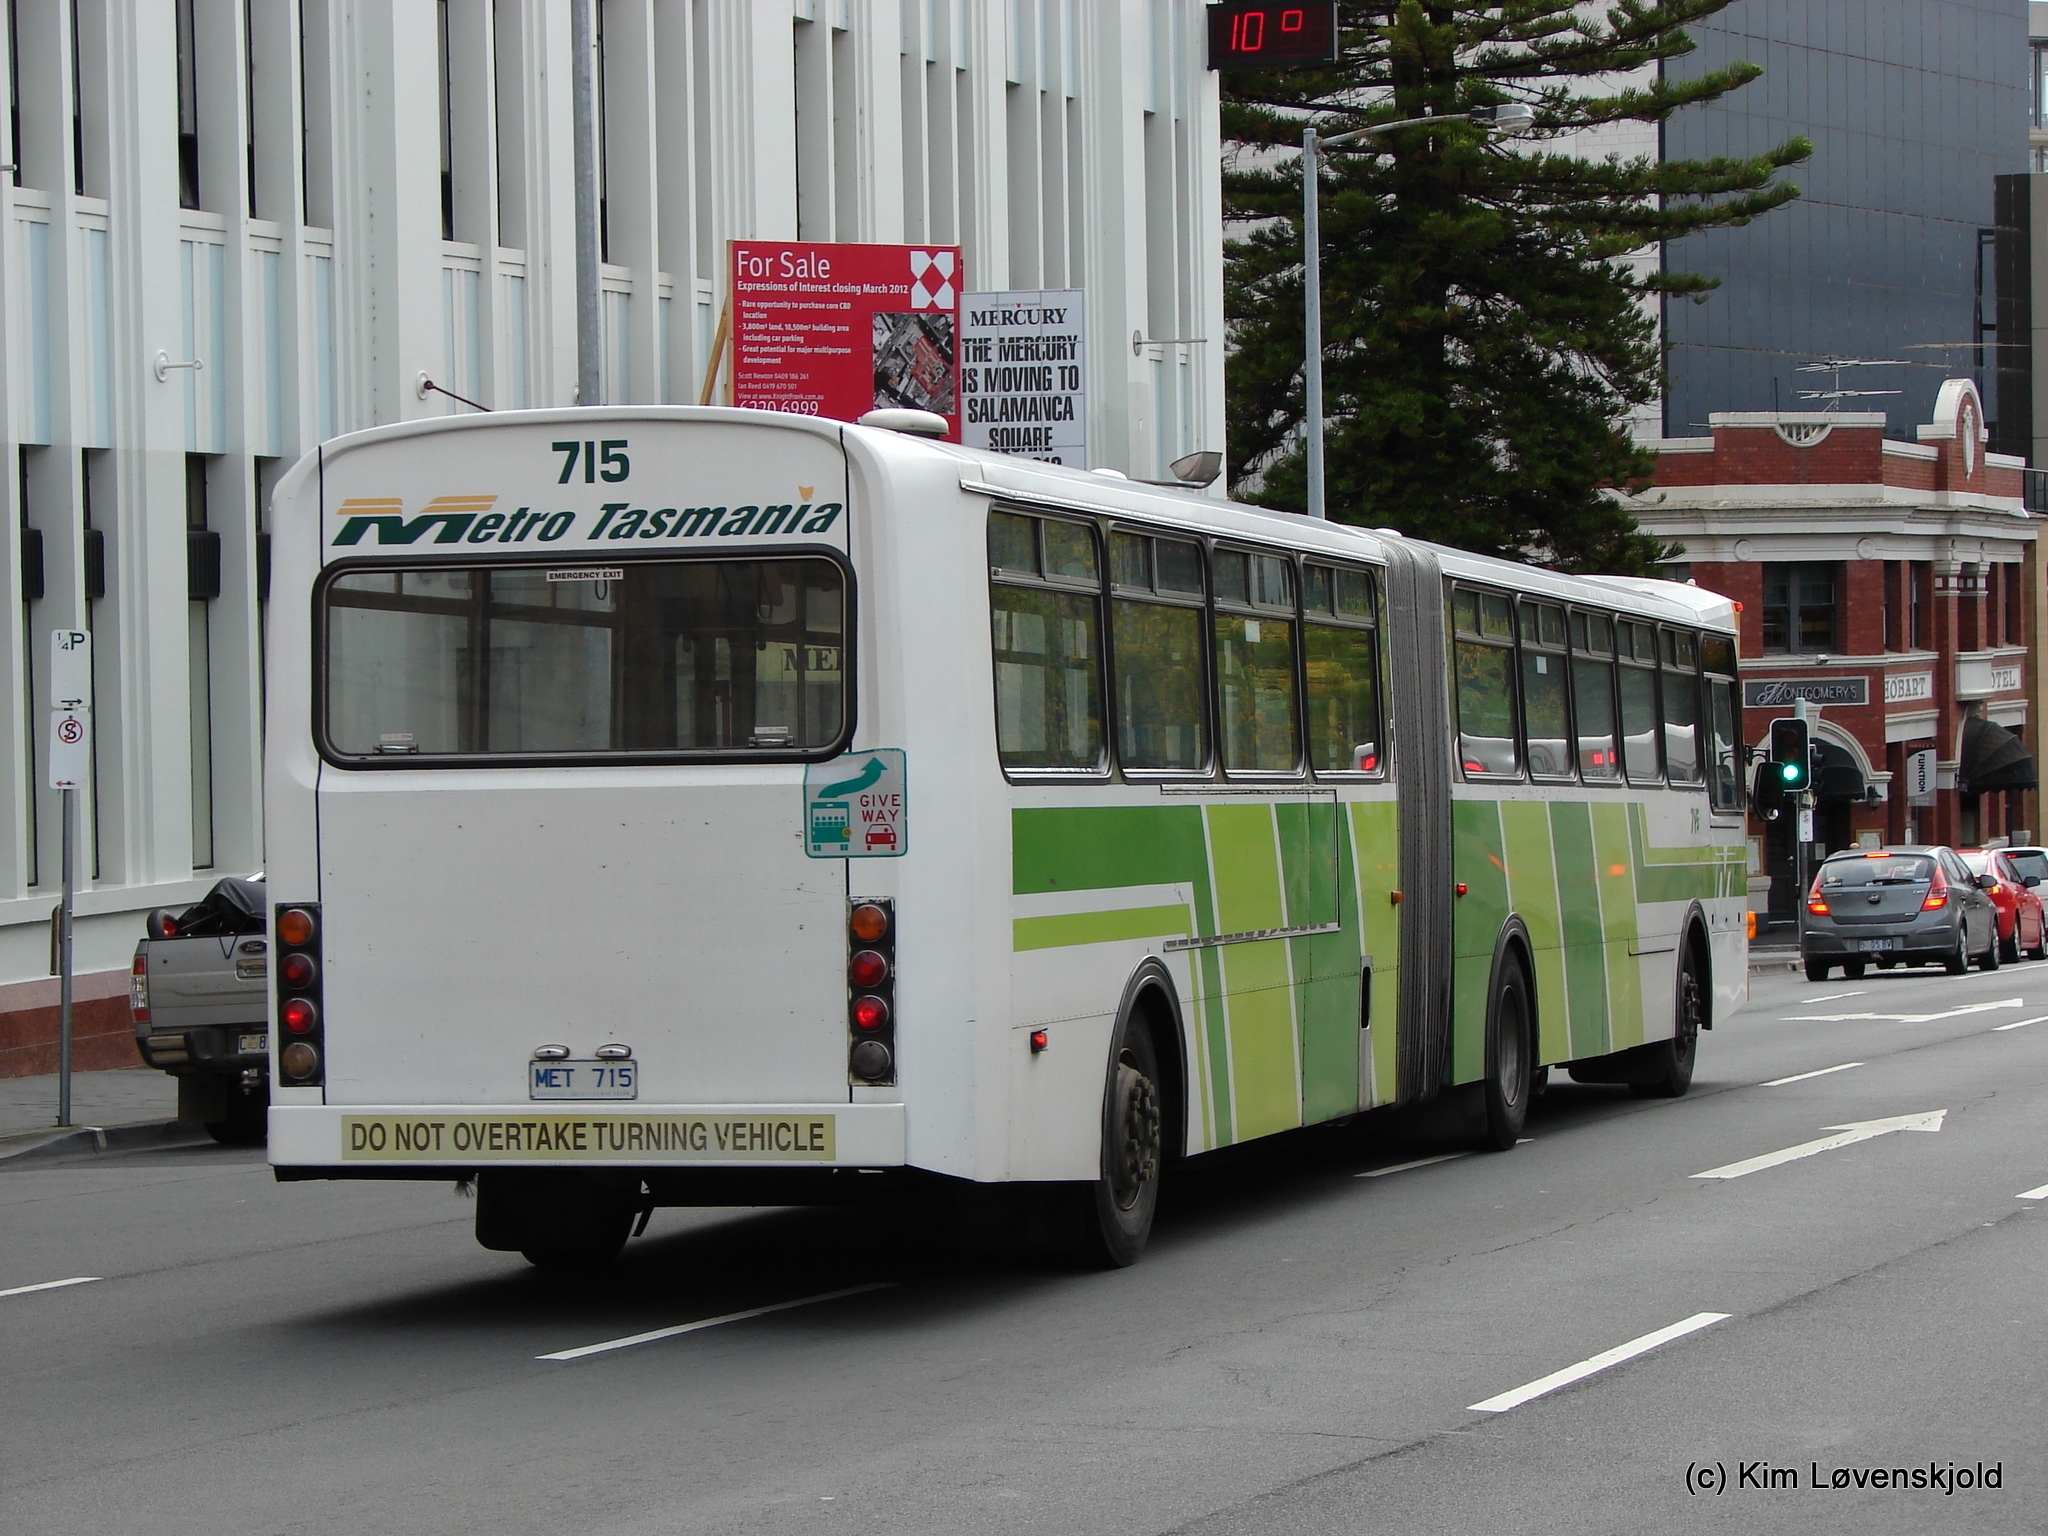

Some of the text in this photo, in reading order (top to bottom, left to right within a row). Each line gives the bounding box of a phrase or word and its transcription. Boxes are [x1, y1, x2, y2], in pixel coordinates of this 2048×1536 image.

[737, 250, 831, 279] For Sale
[737, 280, 909, 295] Expressions of Interest closing March 2012
[742, 300, 756, 308] Rare
[757, 301, 791, 310] opportunity
[799, 302, 826, 310] purchase
[743, 311, 767, 319] location
[970, 308, 1067, 326] MERCURY
[812, 324, 836, 333] building
[743, 334, 770, 343] including
[782, 334, 804, 343] parking
[760, 345, 786, 354] potential
[796, 346, 813, 354] major
[814, 346, 851, 355] multipurpose
[962, 335, 1078, 363] THE MERCURY
[743, 356, 781, 365] development
[961, 365, 1079, 393] IS MOVING TO
[967, 396, 1074, 423] SALAMANCA
[989, 427, 1053, 454] SQUARE
[552, 439, 630, 484] 715
[332, 487, 843, 546] Metro Tasmania
[549, 572, 600, 580] EMERGENCY
[1918, 754, 1926, 792] FUNCTION
[860, 794, 901, 807] GIVE
[862, 810, 900, 822] WAY
[535, 1068, 632, 1088] MET 715
[351, 1122, 825, 1152] DO NOT OVERTAKE TURNING VEHICLE
